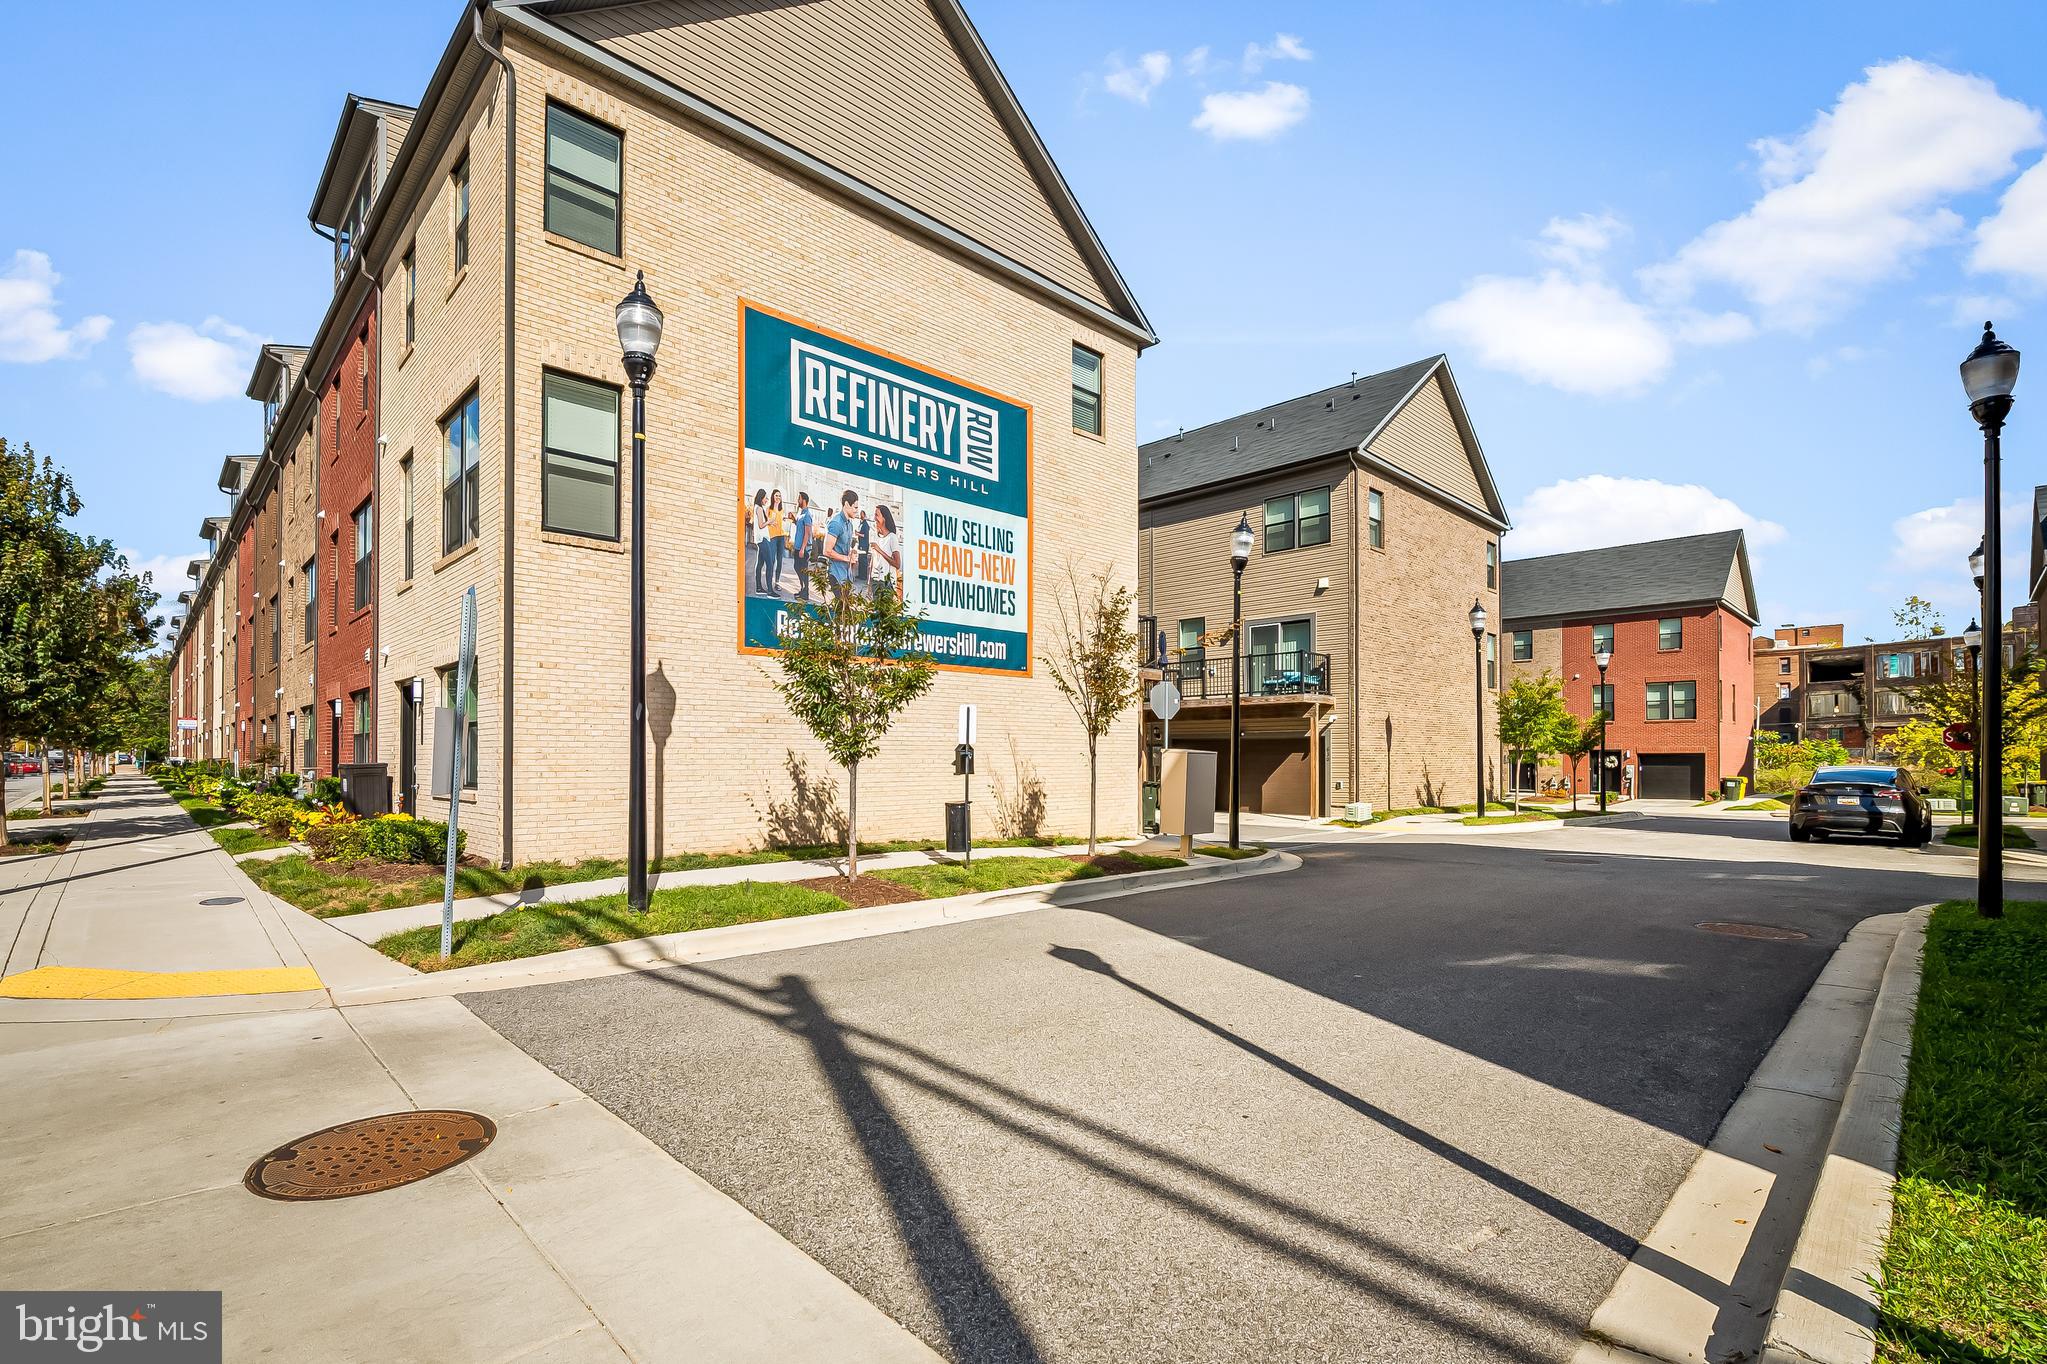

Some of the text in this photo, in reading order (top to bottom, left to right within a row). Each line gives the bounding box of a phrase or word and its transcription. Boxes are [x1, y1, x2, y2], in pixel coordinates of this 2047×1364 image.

[804, 356, 957, 456] REFINERY
[802, 435, 990, 495] AT BREWERS HILL
[967, 407, 993, 474] ROW
[923, 510, 1014, 554] NOW SELLING
[918, 539, 1016, 586] BRAND-NEW
[918, 574, 1016, 617] TOWNHOMES
